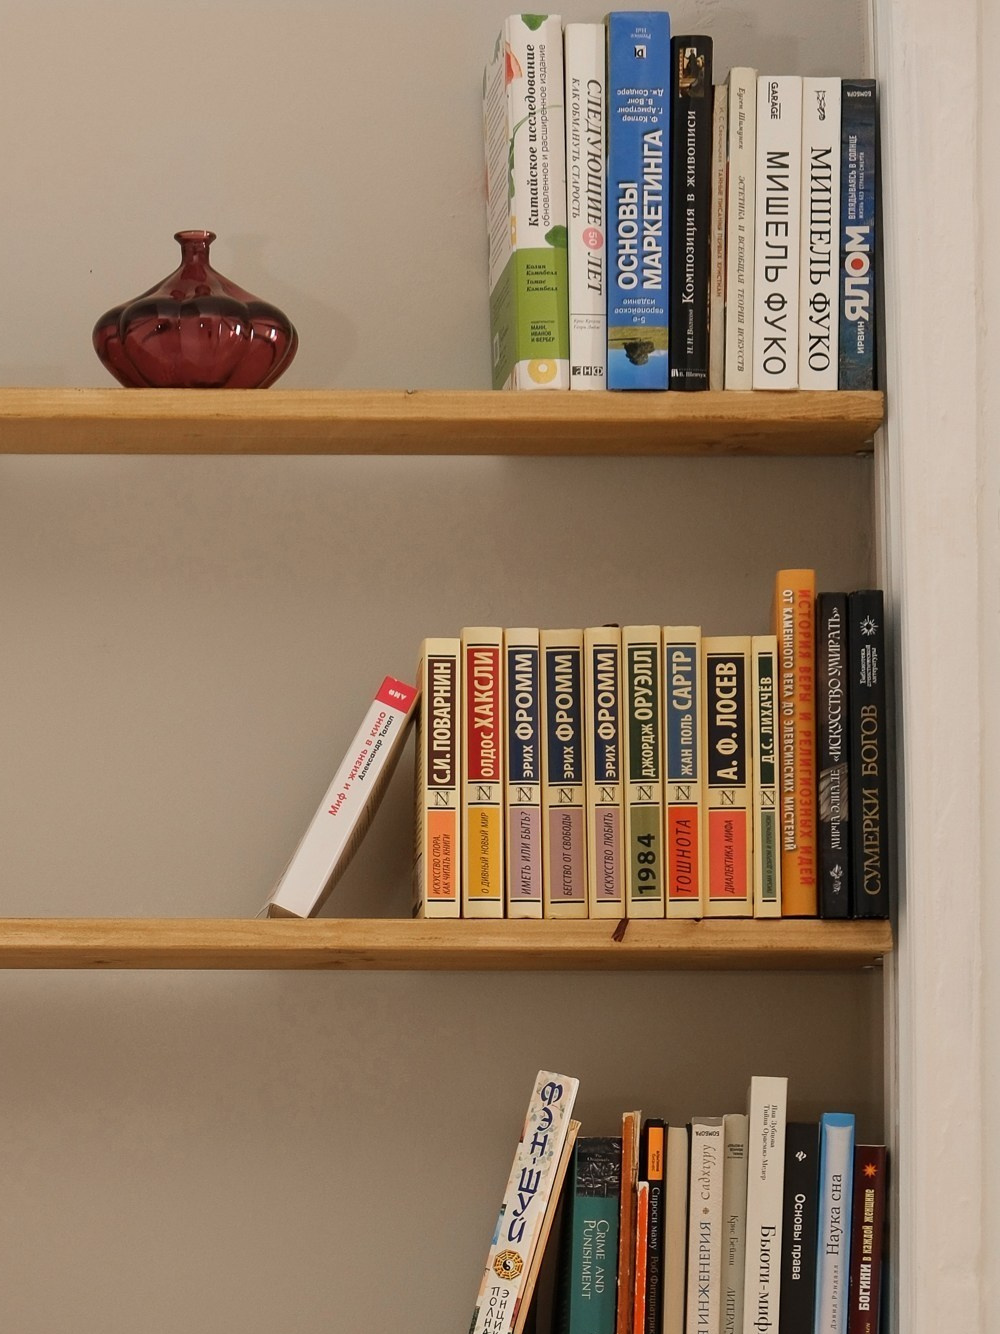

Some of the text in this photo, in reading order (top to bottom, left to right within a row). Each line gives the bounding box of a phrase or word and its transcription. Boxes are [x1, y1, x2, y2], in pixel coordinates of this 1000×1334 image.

[539, 43, 548, 83] издание
[525, 44, 539, 226] Китайское исследование
[540, 86, 551, 151] расширенное
[571, 79, 580, 219] КАК ОБМАНУТЬ СТАРОСТЬ
[541, 163, 550, 227] обновленное
[585, 80, 603, 296] СЛЕДУЮЩИЕ 50 ЛЕТ
[618, 182, 638, 290] ОСНОВЫ
[643, 130, 663, 290] МАРКЕТИНГА
[682, 208, 698, 304] Композиция
[763, 152, 789, 375] МИШЕЛЬ ФУКО
[808, 147, 831, 372] МИШЕЛЬ ФУКО
[845, 226, 870, 354] ИРВИН ЯЛОМ
[433, 663, 451, 783] С.И. ПОВАРНИН
[474, 652, 496, 777] ОЛДОС ХАКСЛИ
[514, 654, 534, 778] ЭРИХ ФРОММ
[555, 656, 574, 779] ЭРИХ ФРОММ
[597, 653, 616, 778] ЭРИХ ФРОММ
[634, 651, 656, 777] ДЖОРДЖ ОРУЭЛЛ
[671, 651, 692, 775] ЖАН ПОЛЬ САРТР
[716, 662, 738, 780] А. Ф. ЛОСЕВ
[479, 830, 489, 855] НОВЫЙ
[480, 812, 489, 828] МИР
[520, 812, 531, 894] ИМЕТЬ ИЛИ БЫТЬ?
[861, 704, 881, 895] СУМЕРКИ БОГОВ
[479, 857, 490, 887] ДИВНЫЙ
[562, 814, 572, 895] БЕГСТВО ОТ СВОБОДЫ
[637, 834, 656, 894] 1984
[675, 819, 692, 893] ТОШНОТА
[507, 1081, 563, 1245] ФЭН-ШУЙ
[826, 1174, 843, 1256] Наука сна
[864, 1189, 874, 1223] женщине
[697, 1221, 711, 1324] ИНЖЕНЕРИЯ
[791, 1194, 806, 1280] Основы права
[859, 1263, 871, 1311] БОГИНИ
[863, 1225, 874, 1254] каждой
